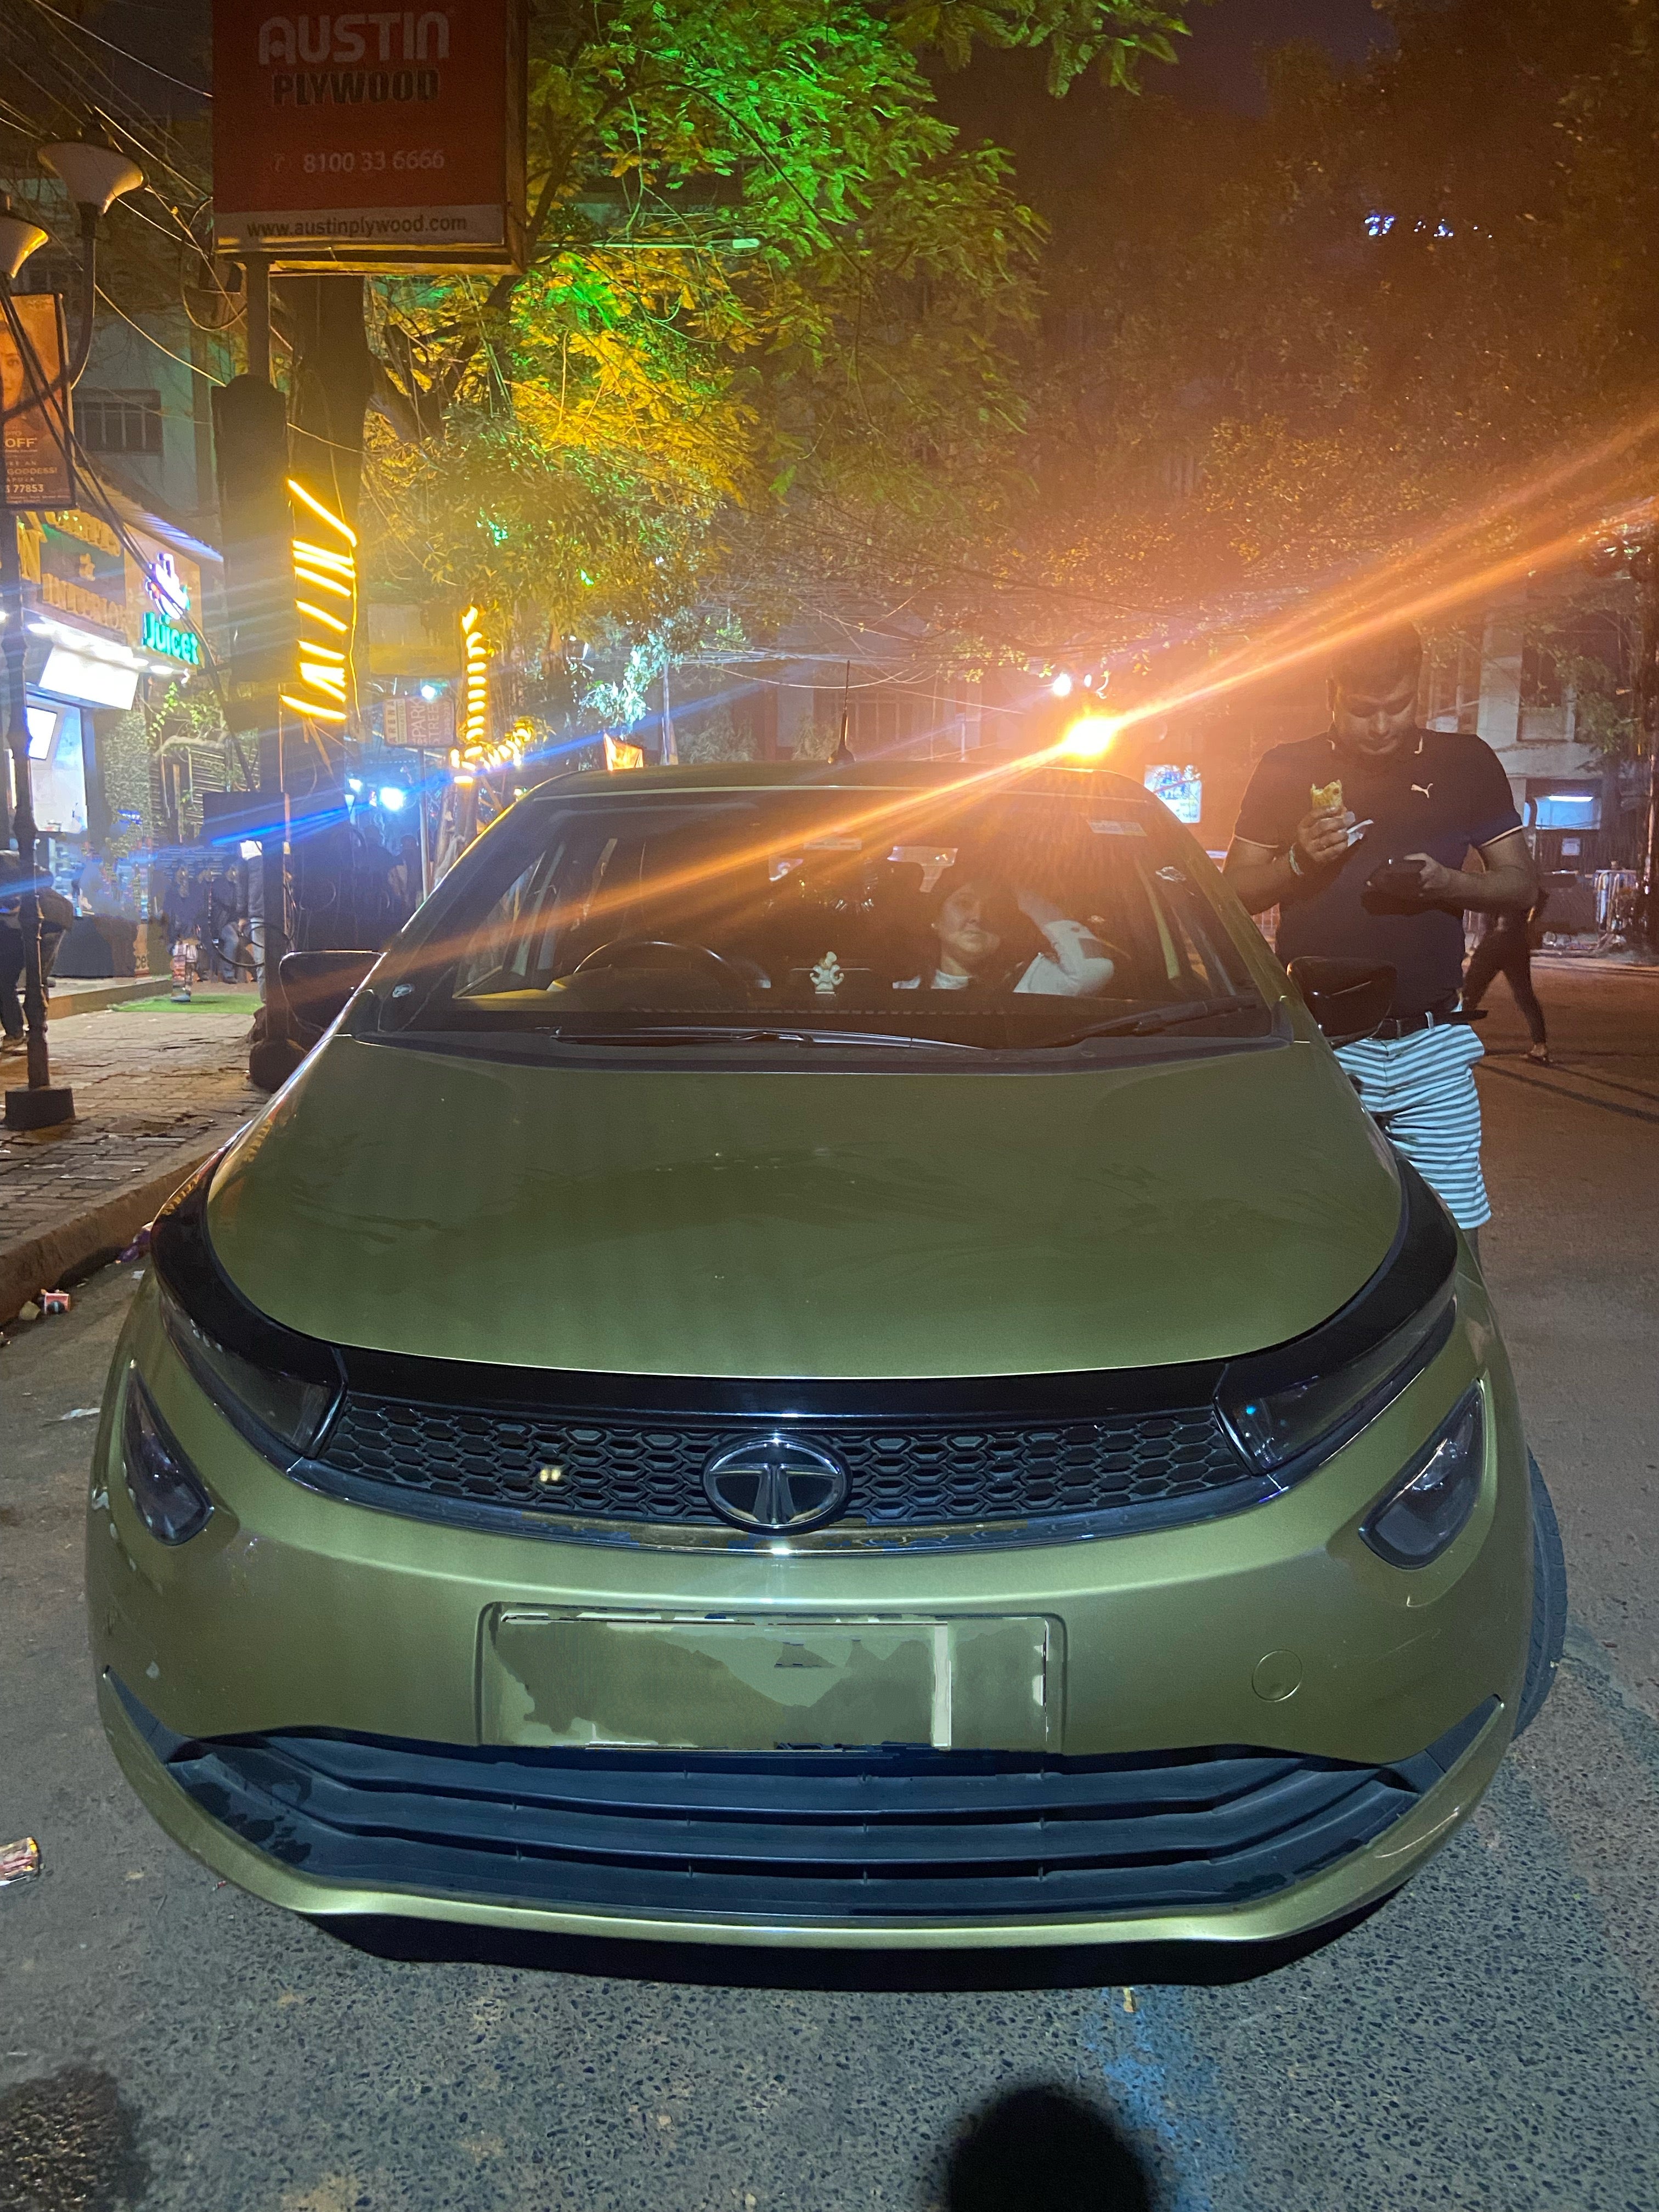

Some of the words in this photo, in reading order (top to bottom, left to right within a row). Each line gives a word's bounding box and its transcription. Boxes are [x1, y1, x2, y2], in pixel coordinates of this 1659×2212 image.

[258, 11, 449, 65] AUSTIN
[273, 69, 439, 106] PLYWOOD
[303, 152, 354, 173] 8100
[393, 150, 445, 170] 6666
[247, 215, 467, 238] www.austinplywood.com
[13, 484, 44, 493] 77853
[428, 699, 439, 745] STREE
